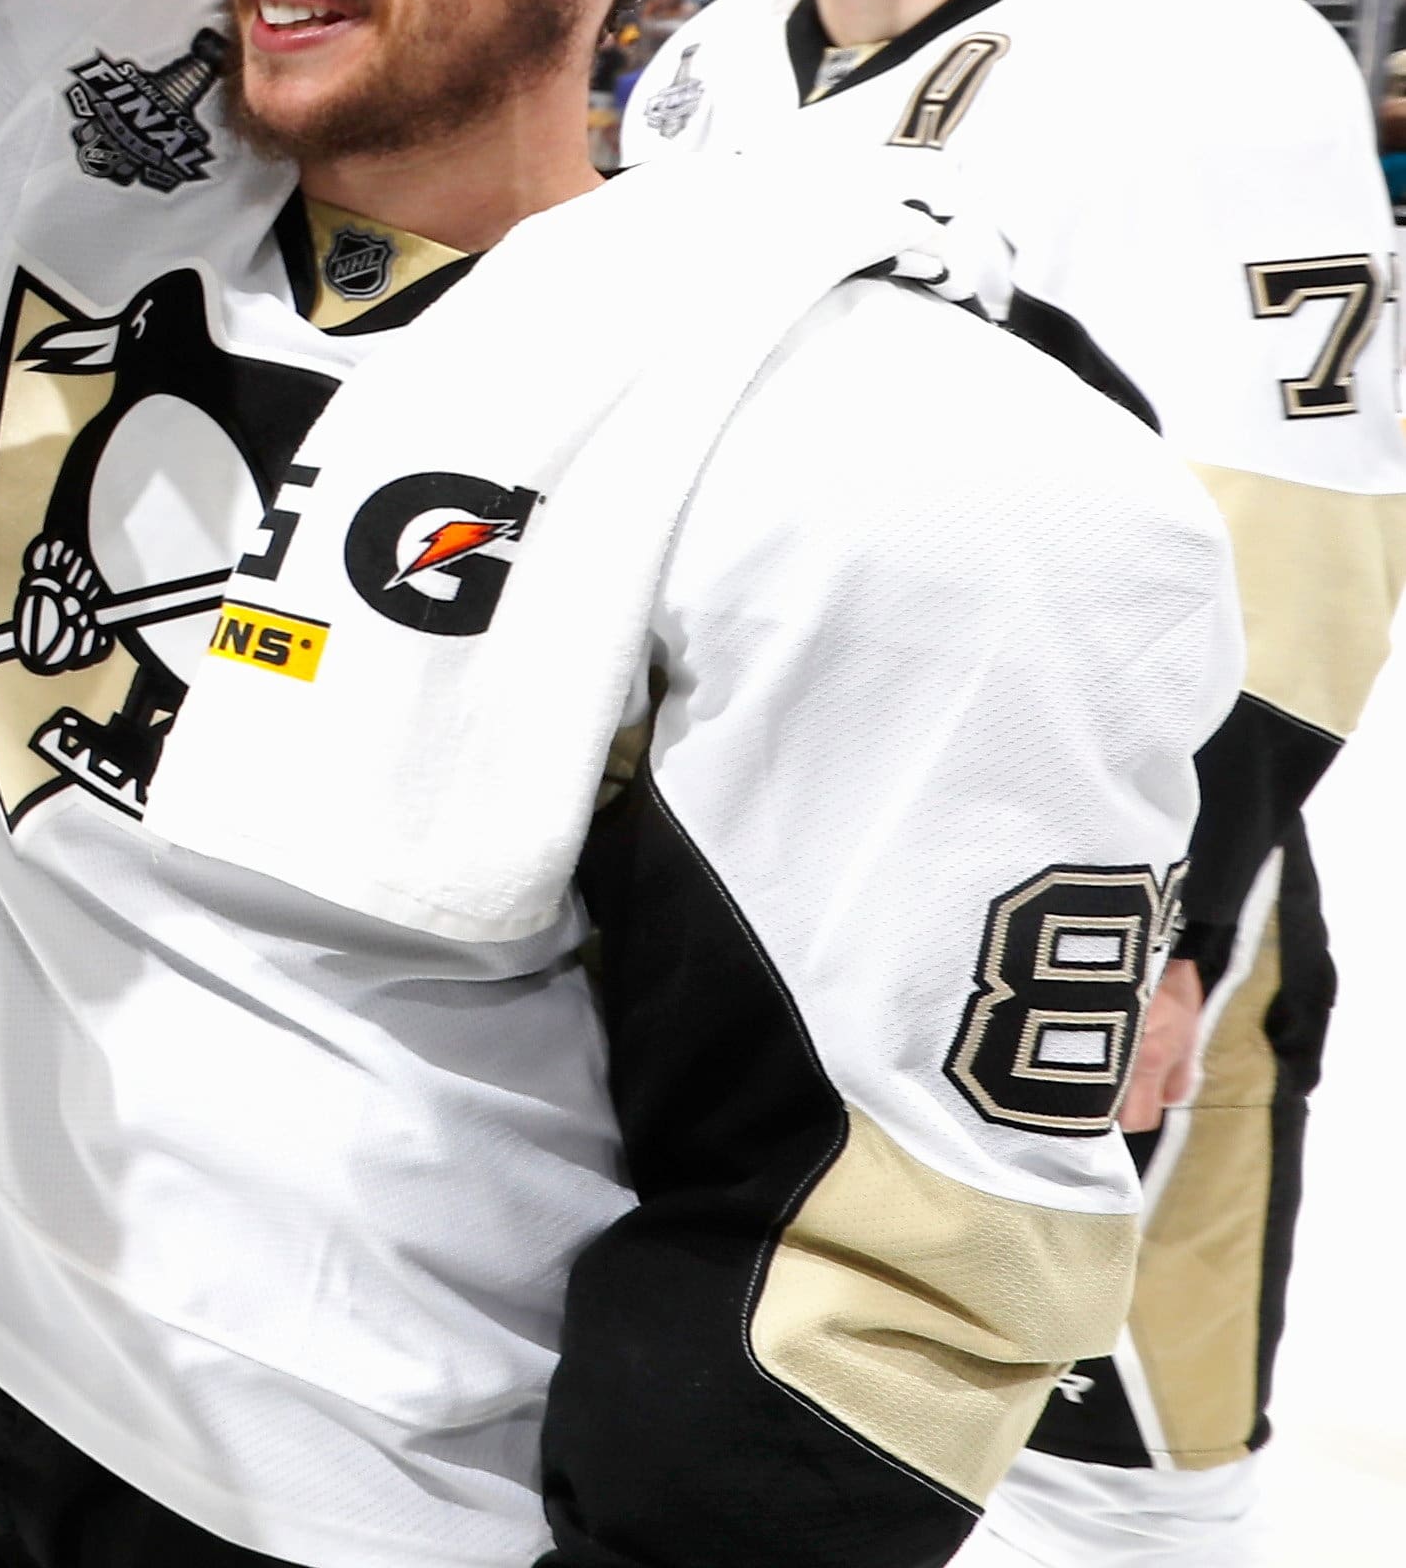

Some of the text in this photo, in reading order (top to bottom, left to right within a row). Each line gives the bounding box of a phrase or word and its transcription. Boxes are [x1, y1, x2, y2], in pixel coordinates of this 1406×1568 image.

[80, 60, 205, 176] FINAL
[117, 62, 180, 115] STANLEY
[887, 30, 1010, 150] A
[334, 252, 380, 278] NHL
[344, 471, 540, 636] G
